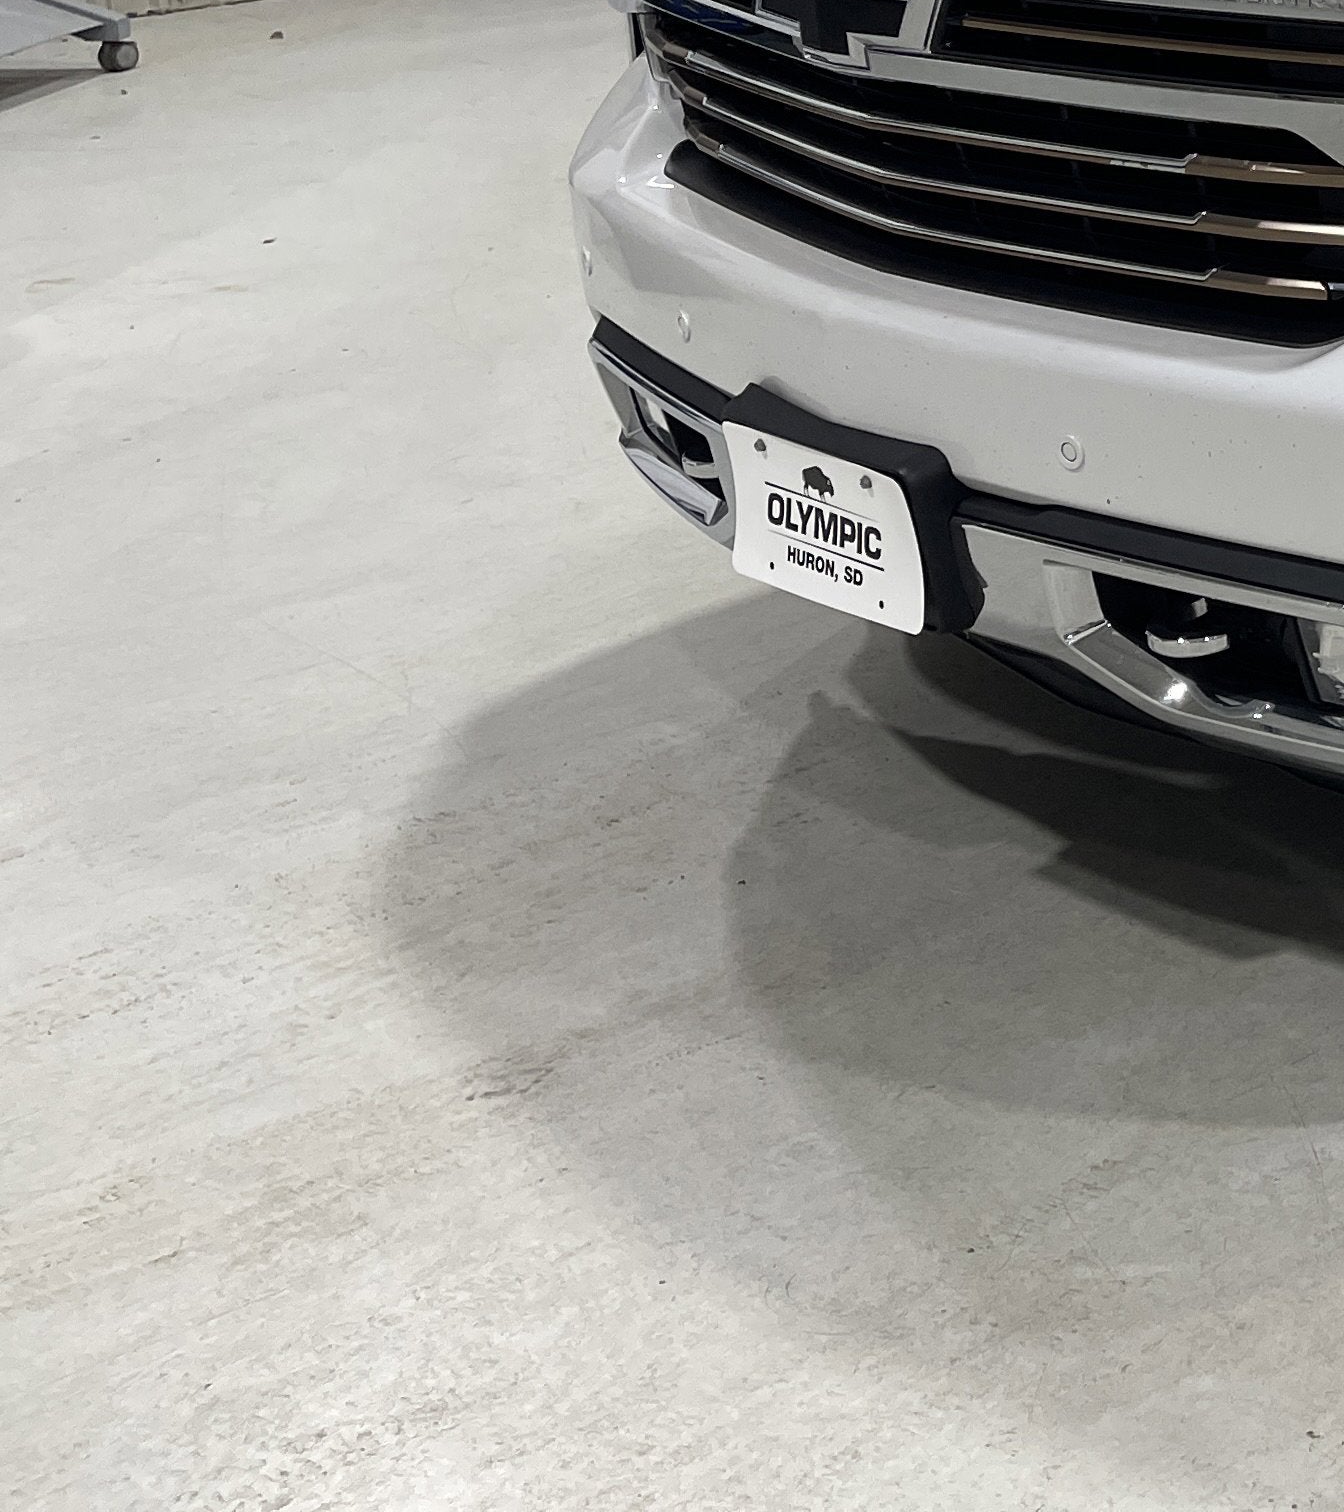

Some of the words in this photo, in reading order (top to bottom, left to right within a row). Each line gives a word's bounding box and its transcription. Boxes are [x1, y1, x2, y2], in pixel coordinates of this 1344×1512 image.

[767, 492, 882, 560] OLYMPIC
[787, 545, 838, 582] HURON,
[844, 566, 864, 586] SD
